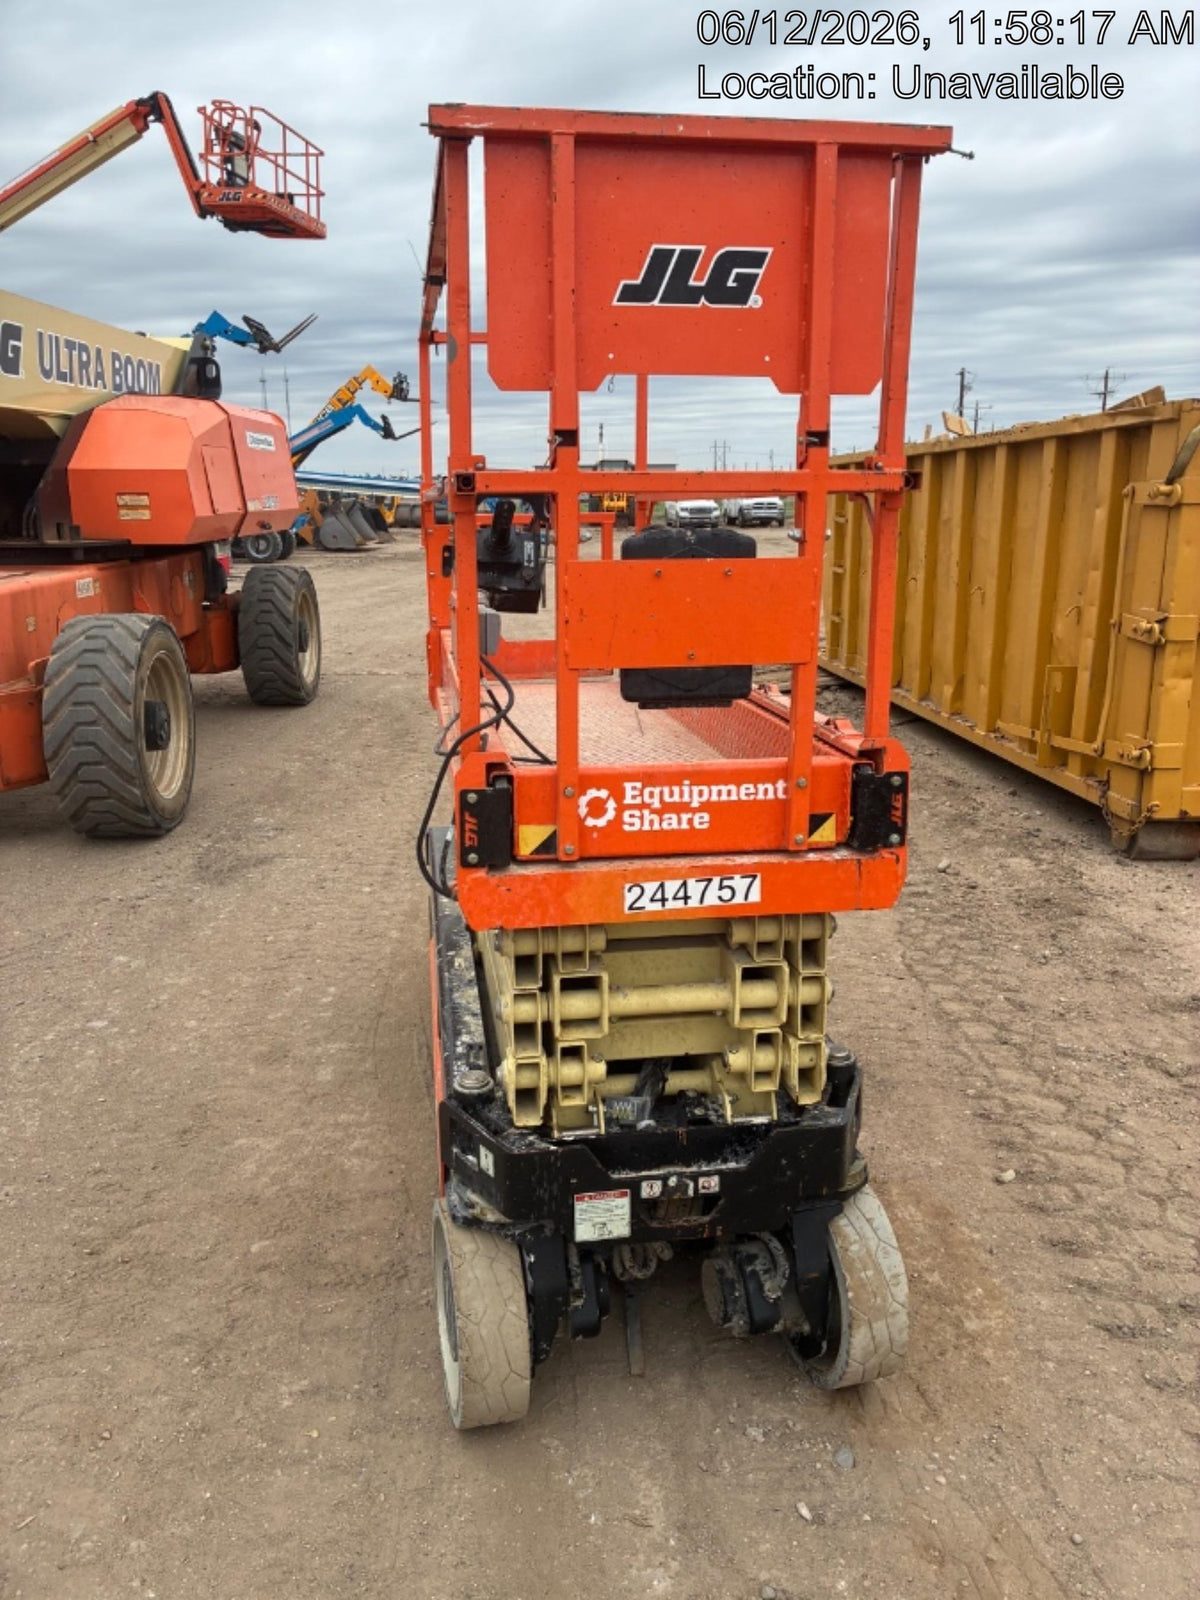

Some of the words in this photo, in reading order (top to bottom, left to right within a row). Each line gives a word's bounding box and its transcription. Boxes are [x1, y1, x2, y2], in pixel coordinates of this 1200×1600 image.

[613, 244, 773, 308] JLG
[37, 329, 108, 392] ULTRA
[111, 350, 162, 395] BOOM
[622, 778, 788, 809] Equipment
[890, 792, 903, 827] JLG
[464, 811, 479, 847] JLG
[622, 808, 711, 832] Share
[626, 873, 759, 912] 244757
